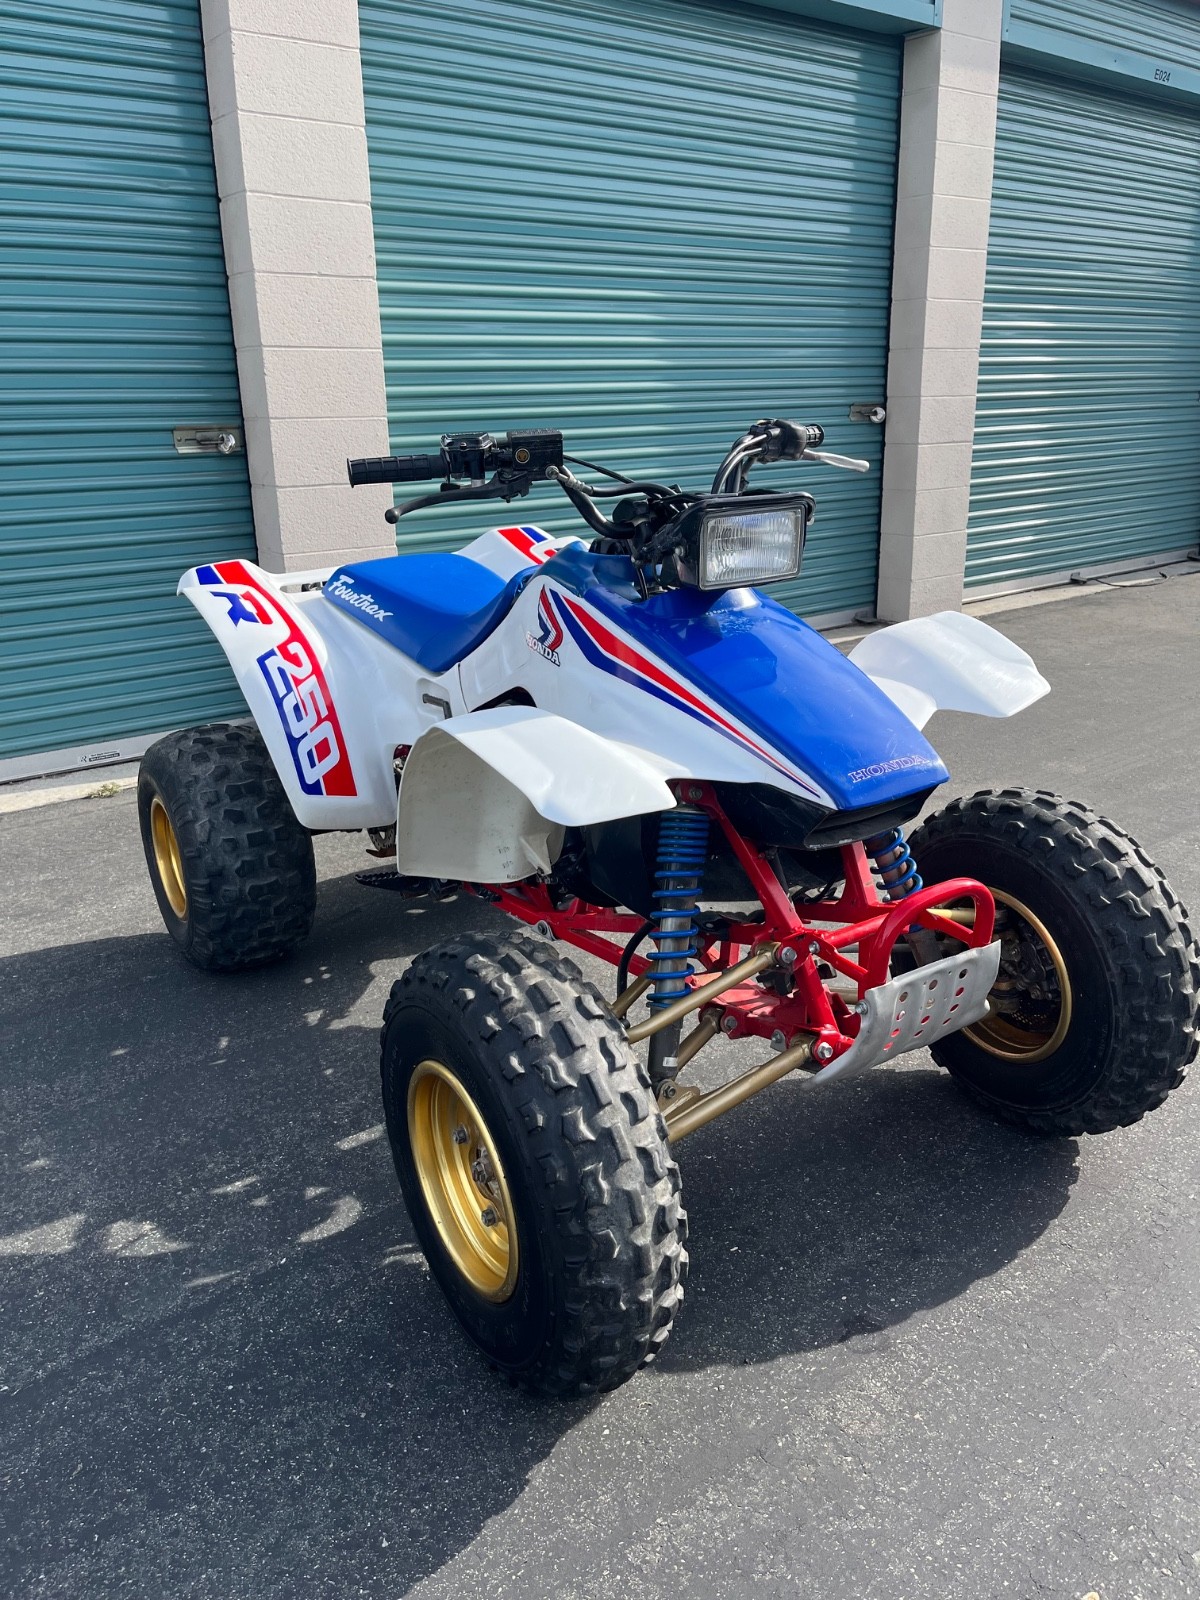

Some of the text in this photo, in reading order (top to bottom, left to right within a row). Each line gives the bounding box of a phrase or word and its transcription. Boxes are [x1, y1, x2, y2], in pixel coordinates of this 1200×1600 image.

[1154, 68, 1171, 82] E024
[327, 574, 394, 622] Fourtrax
[525, 631, 561, 667] HONDA
[264, 641, 340, 785] 250
[847, 755, 931, 783] HONDA
